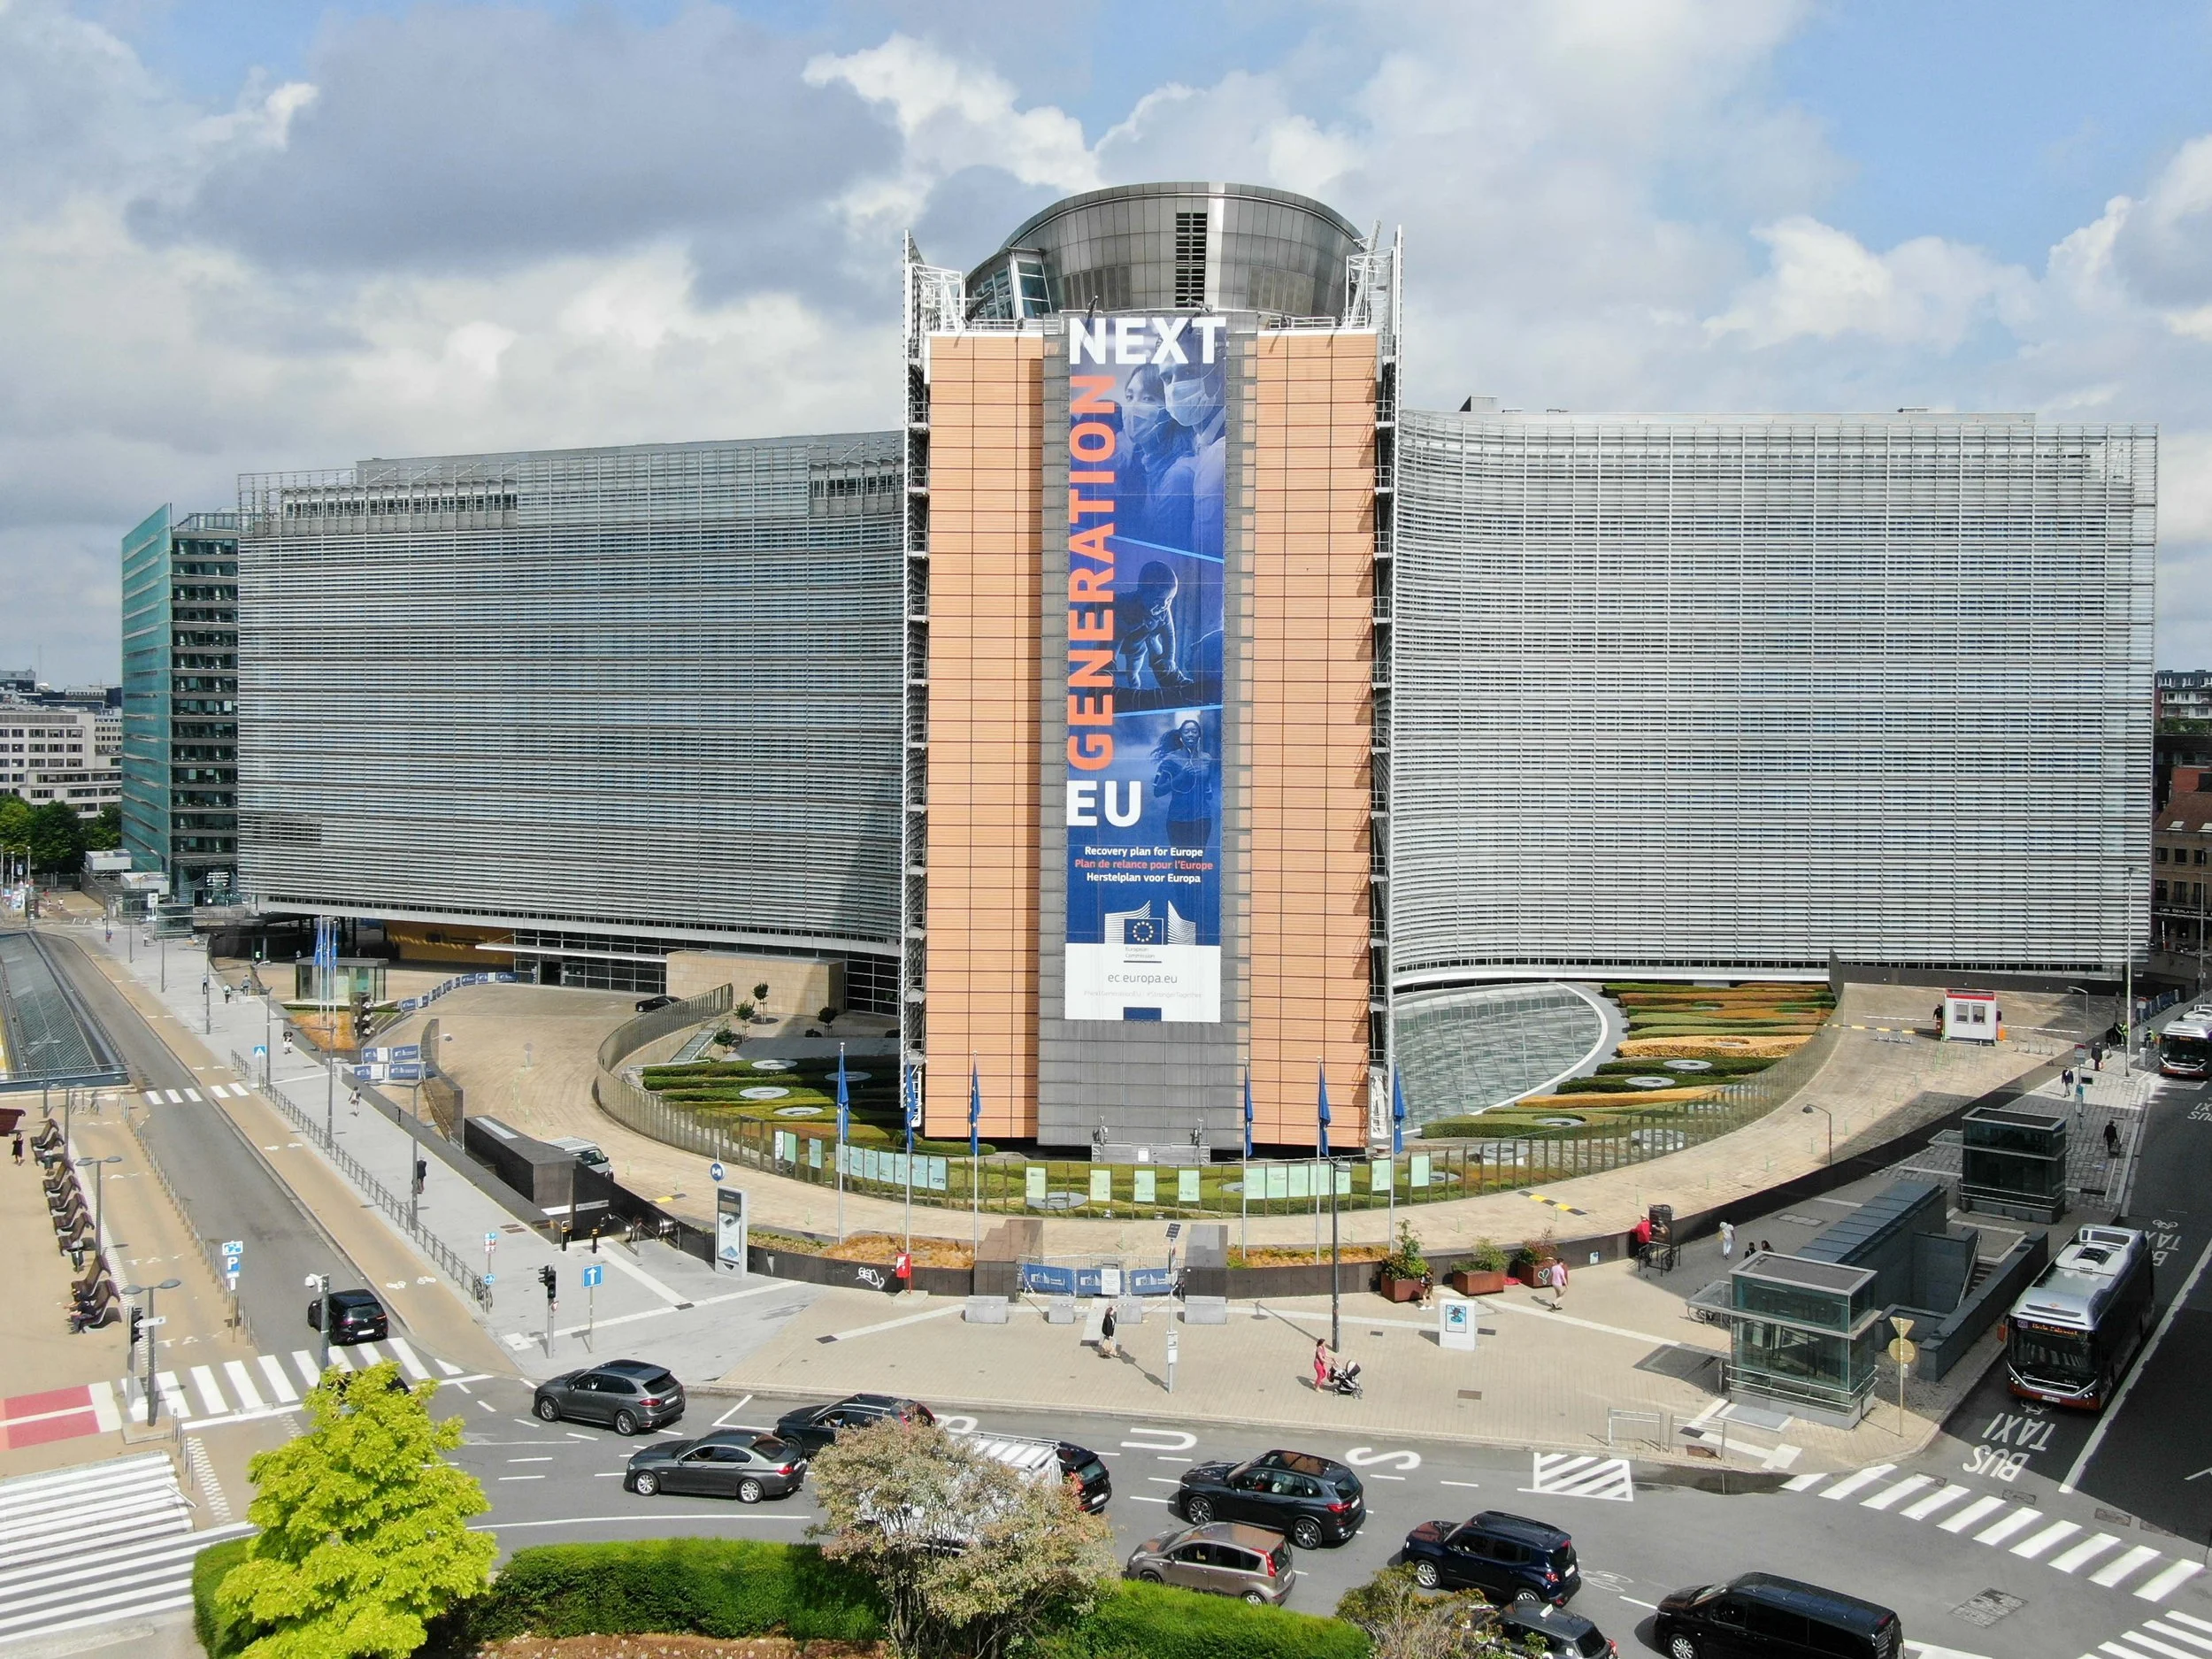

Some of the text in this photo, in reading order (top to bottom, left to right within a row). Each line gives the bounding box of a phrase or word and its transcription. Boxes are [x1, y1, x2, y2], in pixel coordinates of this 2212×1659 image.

[1069, 317, 1227, 365] NEXT
[1067, 375, 1117, 771] GENERATION
[1066, 780, 1141, 827] EU
[1075, 859, 1095, 868] Plan
[1098, 859, 1110, 868] de
[1112, 860, 1148, 869] relance
[1150, 862, 1172, 871] pour
[1085, 847, 1203, 857] Recovery plan for Europe
[1087, 872, 1201, 884] Herstelplan voor Europa
[1108, 973, 1178, 985] ec.europa.eu
[227, 1256, 238, 1271] P
[1982, 1412, 2056, 1451] TAXI
[1962, 1444, 2031, 1482] BUS
